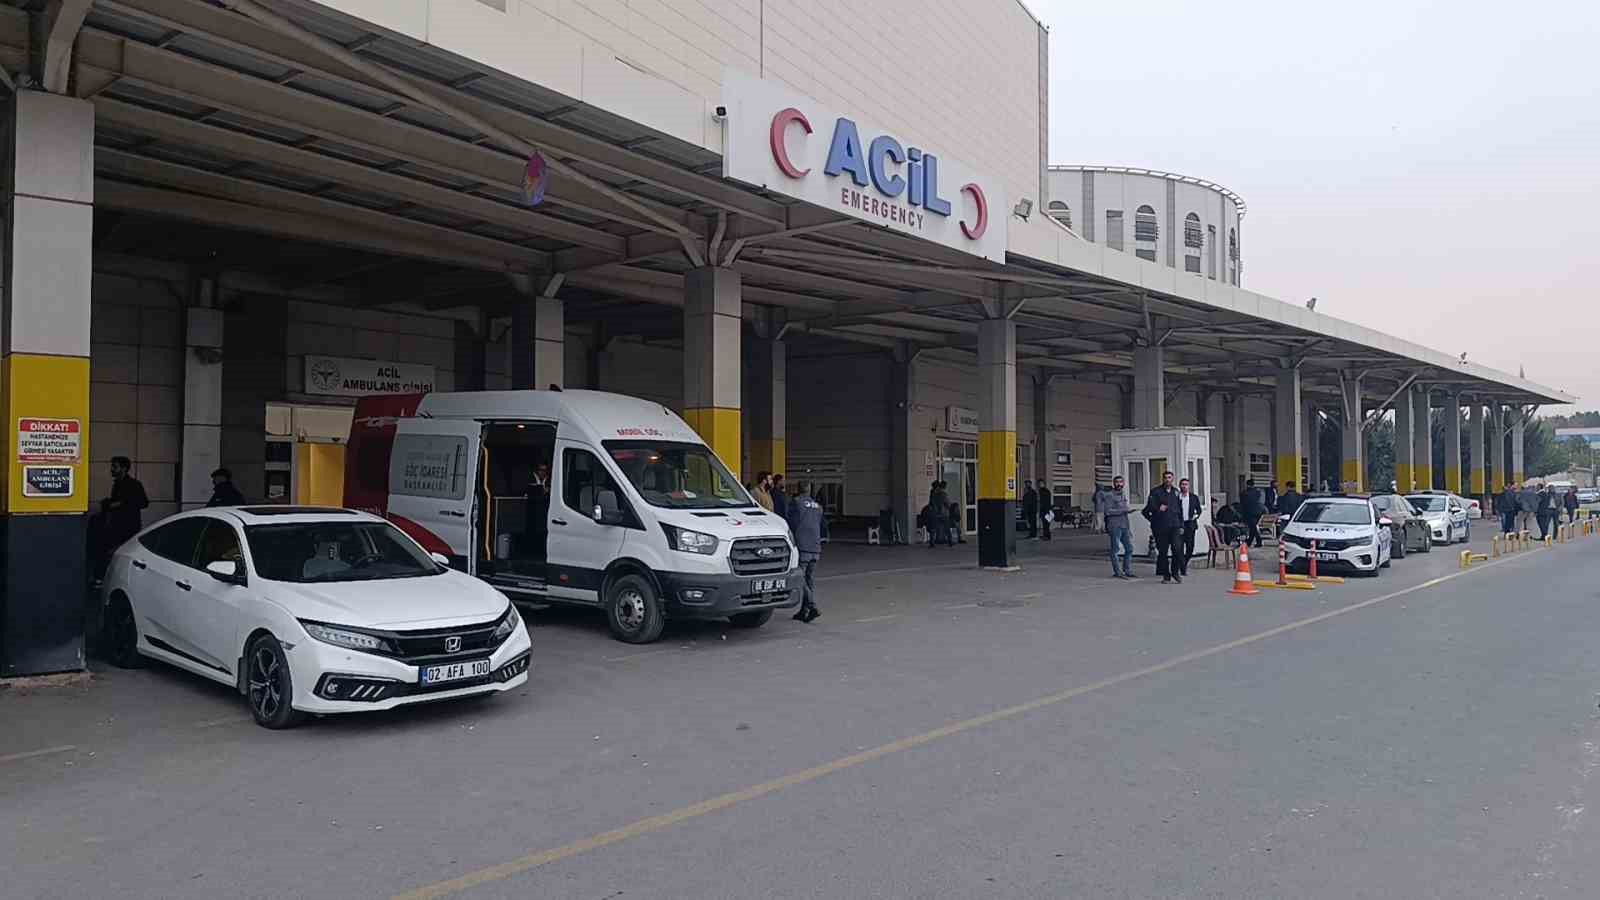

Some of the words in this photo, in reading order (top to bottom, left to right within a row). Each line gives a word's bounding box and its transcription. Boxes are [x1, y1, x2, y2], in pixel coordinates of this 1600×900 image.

[841, 187, 924, 230] EMERGENCY
[342, 379, 401, 393] AMBULANS
[30, 421, 69, 432] DİKKAT!
[428, 668, 441, 681] 02
[447, 665, 465, 678] AFA
[472, 662, 489, 675] 100
